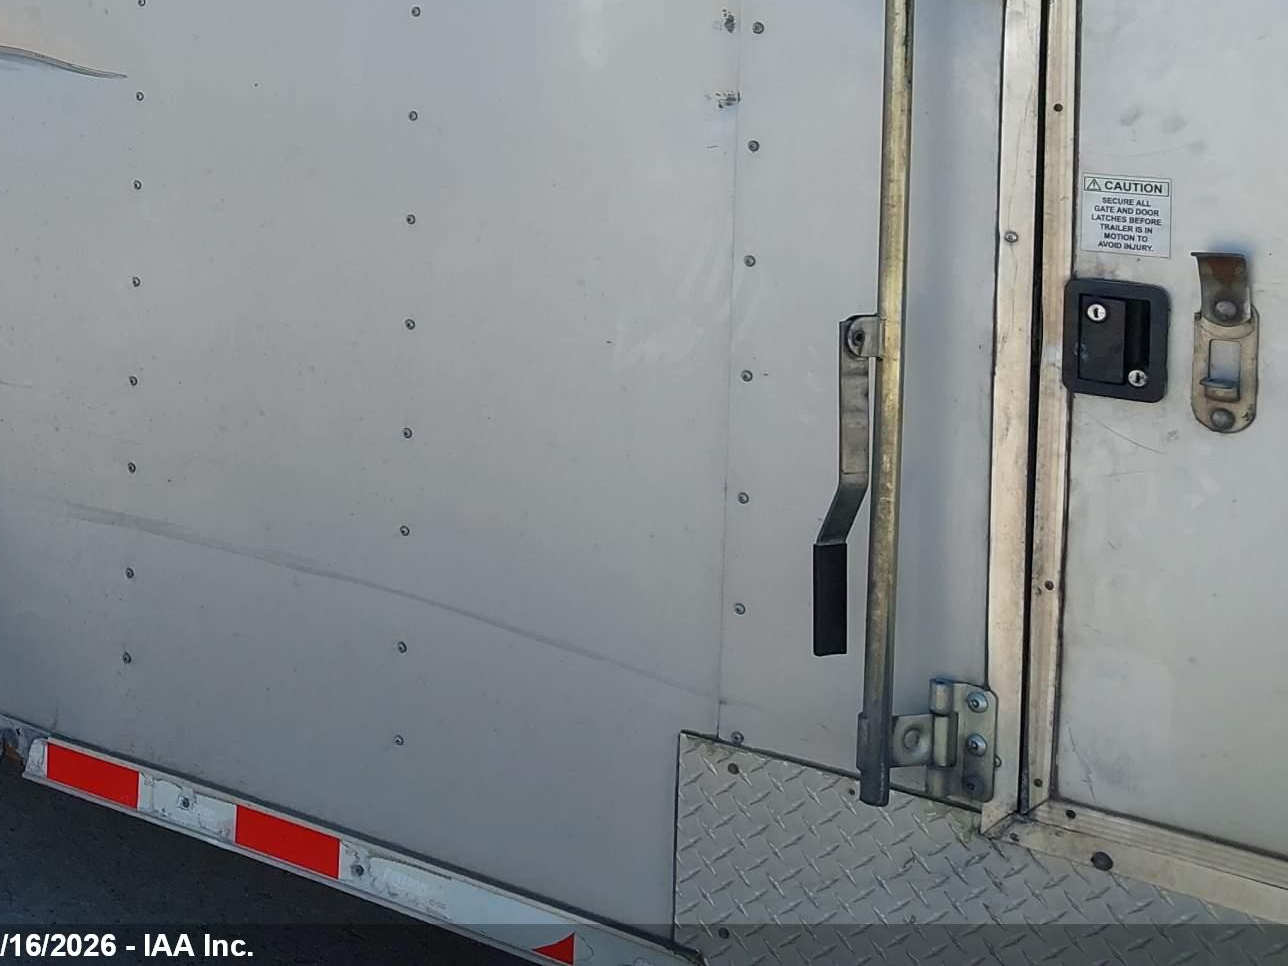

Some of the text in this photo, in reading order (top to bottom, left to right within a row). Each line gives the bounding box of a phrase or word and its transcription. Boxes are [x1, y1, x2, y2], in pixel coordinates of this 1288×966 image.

[1104, 180, 1163, 194] CAUTION
[1102, 197, 1152, 207] SECURE ALL
[1094, 205, 1160, 217] GATE AND DOOR
[1091, 214, 1162, 226] LATCHES BEFORE
[1100, 223, 1133, 232] TRAILER
[1135, 226, 1143, 234] IS
[1104, 233, 1148, 243] MOTION TO
[1097, 241, 1154, 252] AVOID INJURY.
